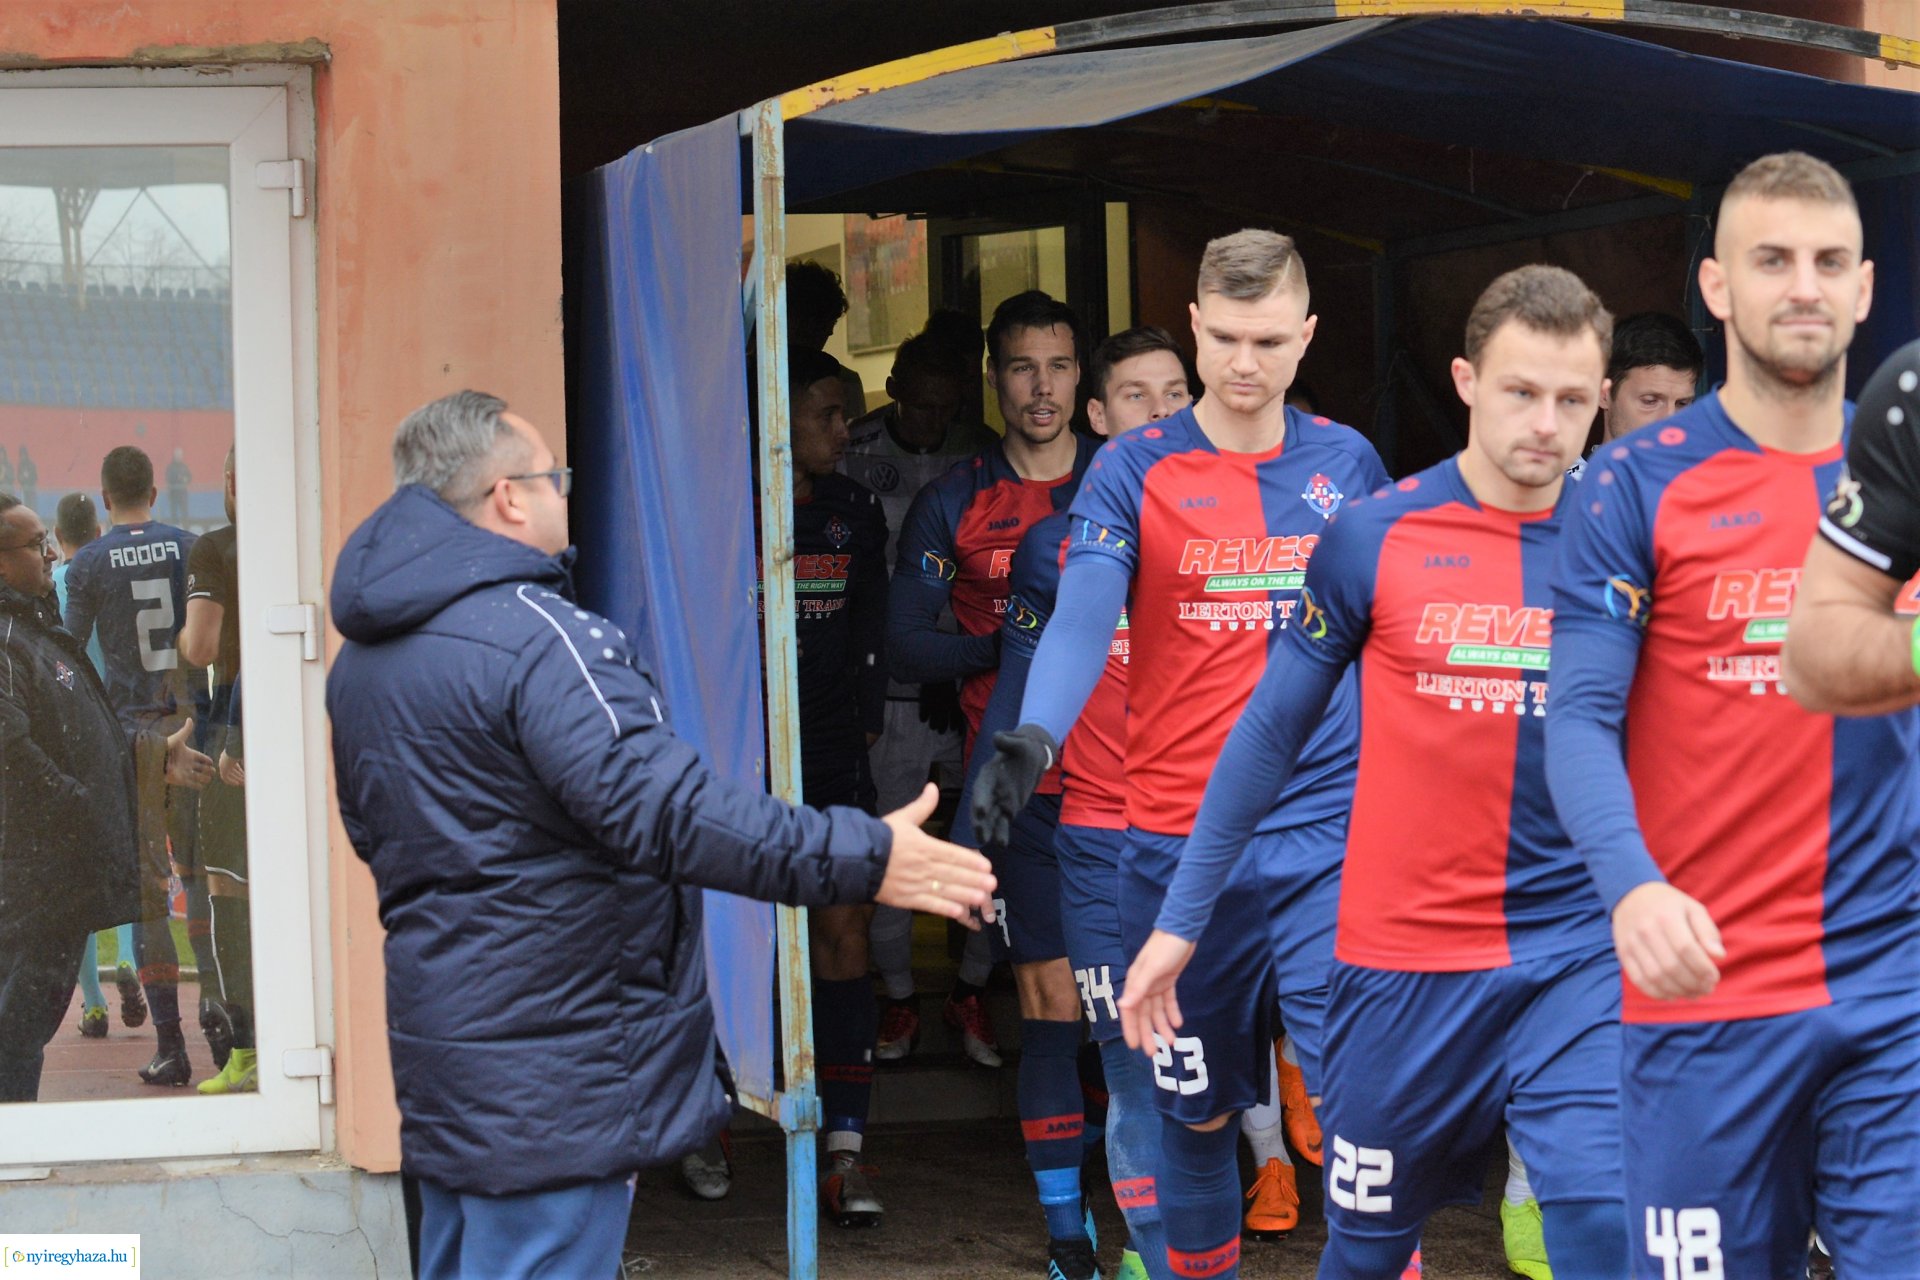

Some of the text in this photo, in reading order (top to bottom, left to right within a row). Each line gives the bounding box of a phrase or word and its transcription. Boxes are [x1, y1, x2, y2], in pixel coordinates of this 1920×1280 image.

[1180, 496, 1217, 509] JAKO
[987, 517, 1019, 531] JAKO
[1710, 511, 1761, 529] JAKO
[1178, 534, 1319, 575] REVES
[1423, 555, 1471, 568] JAKO
[1209, 575, 1304, 587] ALWAYS ON THE RIG
[1179, 601, 1273, 620] LERTON
[1210, 620, 1288, 631] HUNGA
[1415, 603, 1555, 648] REVE
[1453, 650, 1500, 661] ALWAYS
[1502, 652, 1520, 663] ON
[1521, 653, 1543, 664] THE
[1416, 672, 1526, 702] LERTON
[1449, 698, 1547, 716] HUNGA
[1074, 965, 1118, 1022] 34
[1152, 1032, 1209, 1096] 23
[1329, 1134, 1394, 1213] 22
[1645, 1206, 1725, 1280] 48
